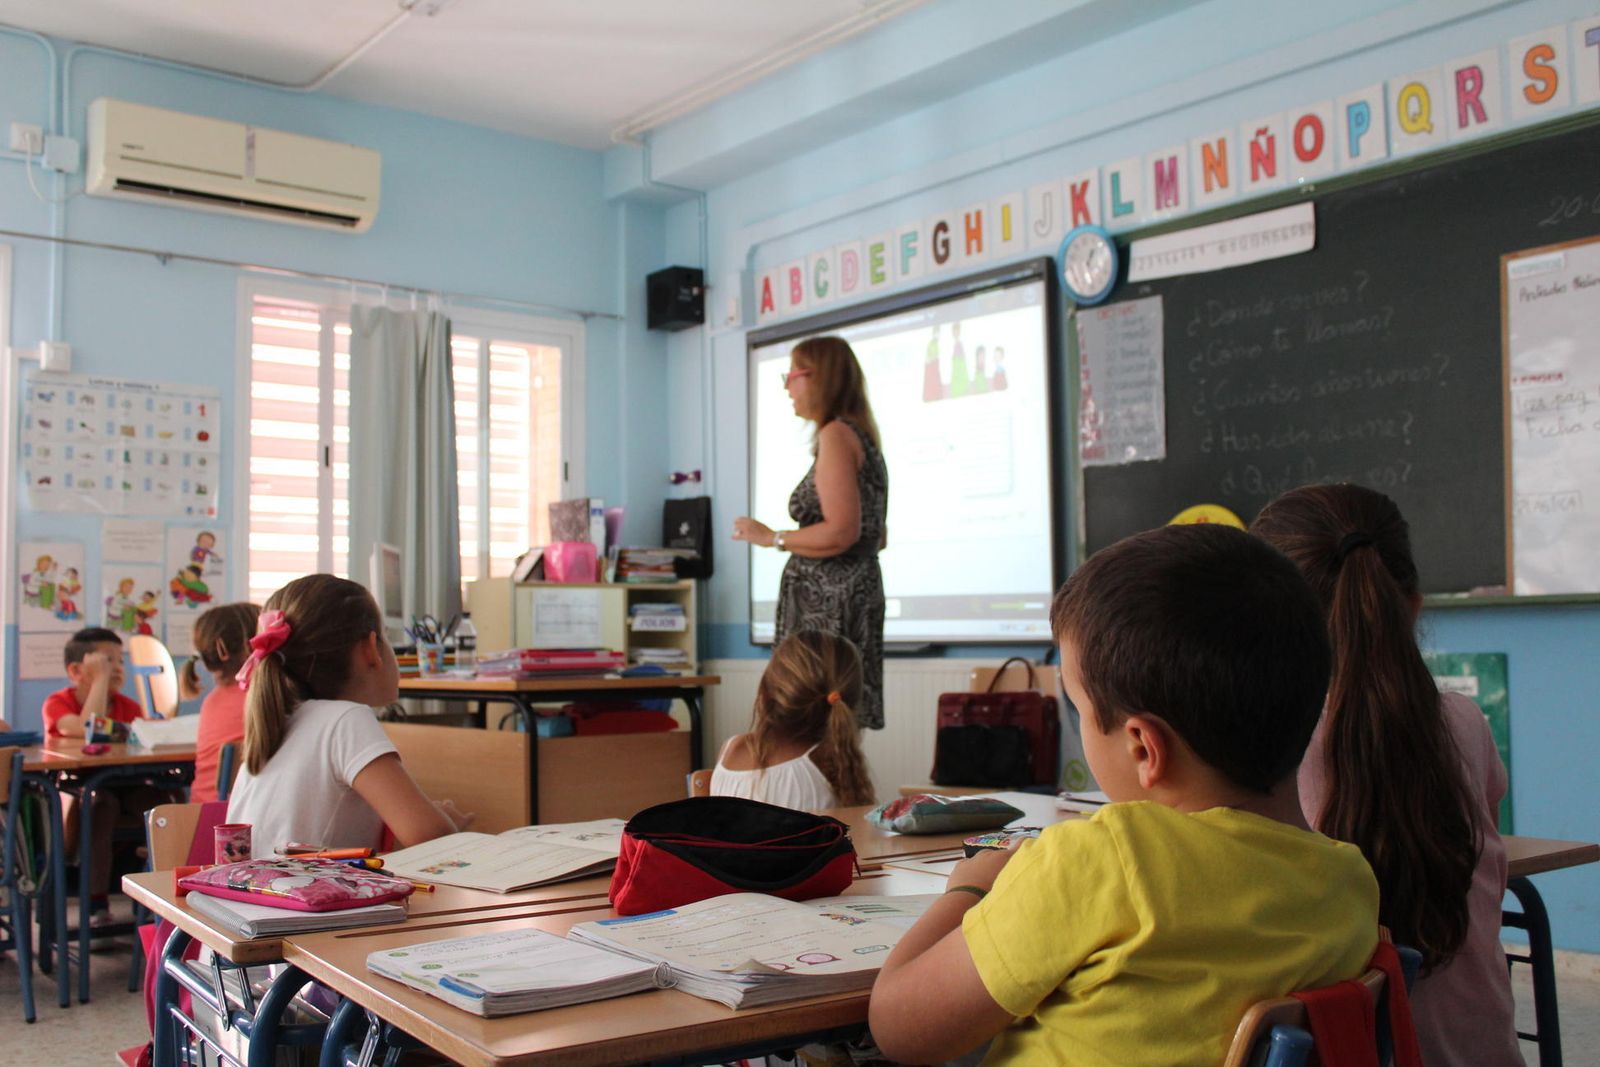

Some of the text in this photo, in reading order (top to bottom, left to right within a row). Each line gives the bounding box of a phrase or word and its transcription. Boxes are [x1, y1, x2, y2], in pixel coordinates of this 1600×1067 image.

[760, 275, 775, 313] A
[789, 267, 803, 305] B
[814, 257, 829, 298] C
[840, 249, 859, 292] D
[870, 243, 886, 284] E
[900, 231, 918, 274] F
[932, 221, 950, 265] G
[964, 210, 983, 256] H
[1001, 204, 1012, 241] I
[1034, 190, 1054, 237] J
[1070, 180, 1092, 228] K
[1111, 172, 1134, 217] L
[1154, 156, 1179, 210] M
[1202, 138, 1228, 193] N
[1250, 127, 1276, 182] Ñ
[1293, 114, 1324, 163] O
[1347, 101, 1371, 157] P
[1397, 82, 1433, 135] Q
[1456, 65, 1488, 129] R
[1523, 43, 1559, 105] S
